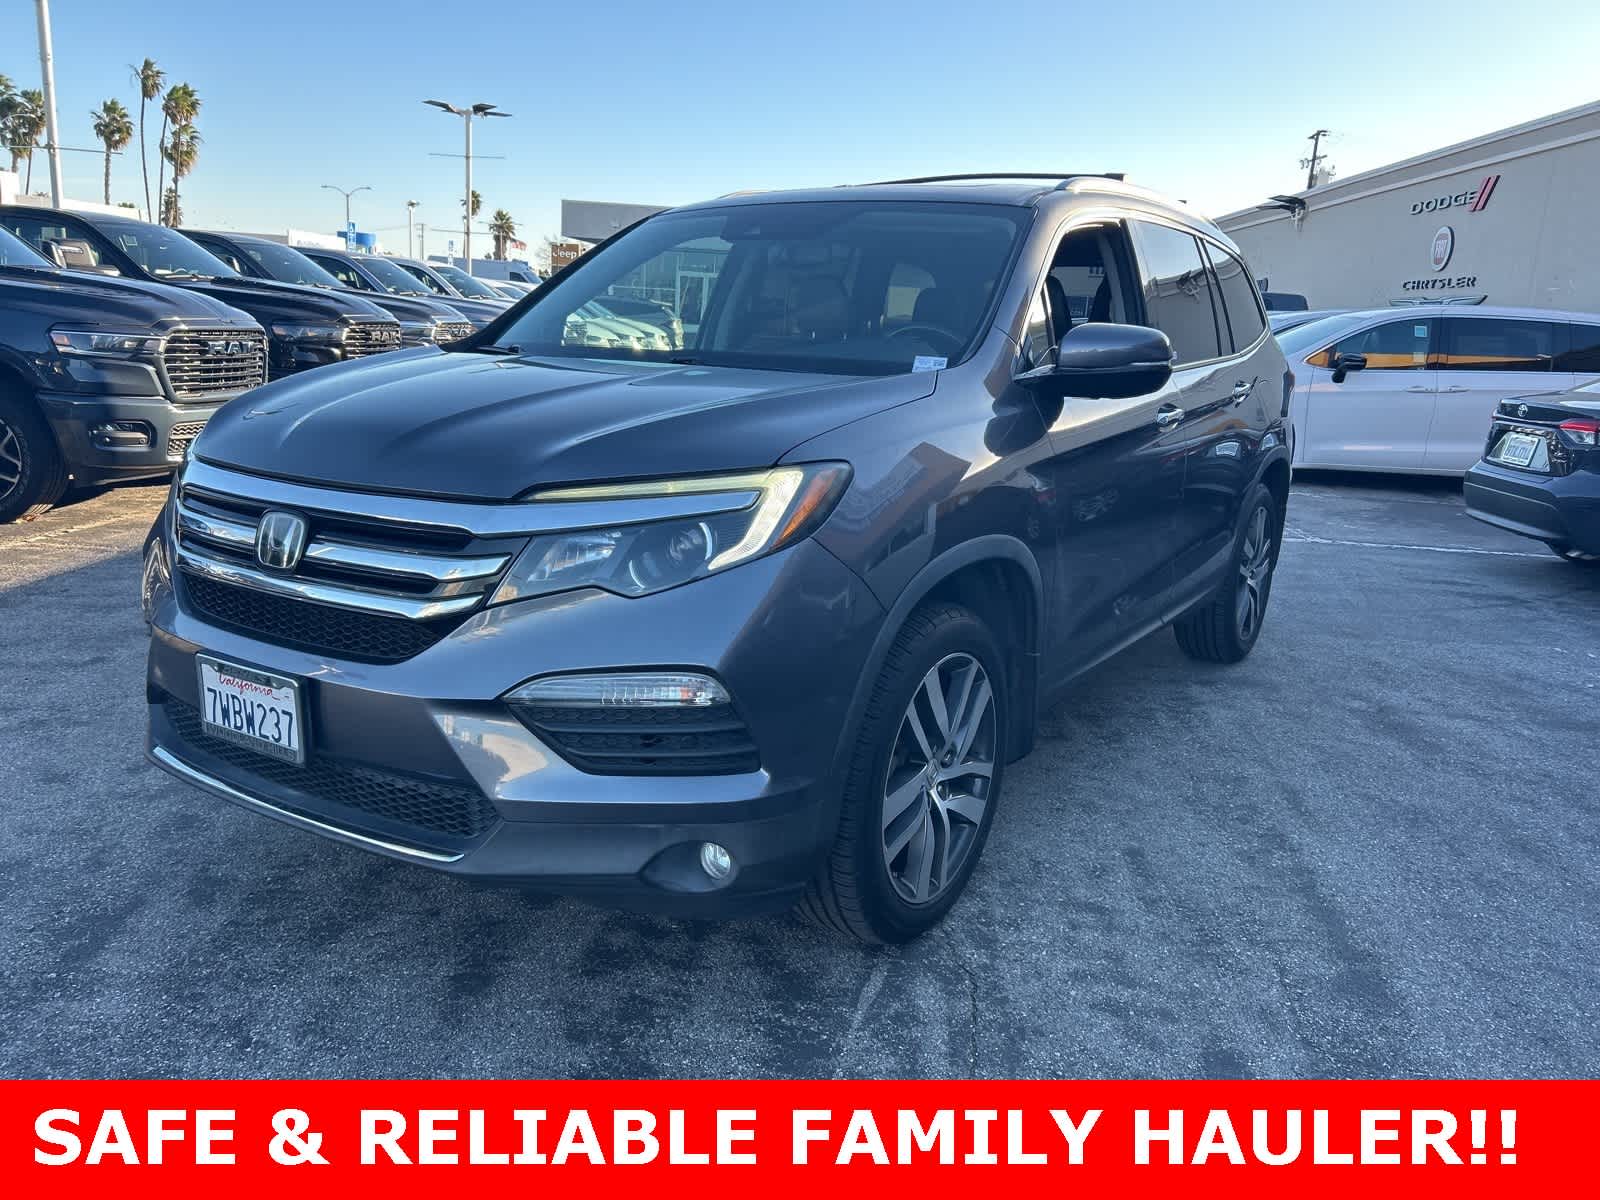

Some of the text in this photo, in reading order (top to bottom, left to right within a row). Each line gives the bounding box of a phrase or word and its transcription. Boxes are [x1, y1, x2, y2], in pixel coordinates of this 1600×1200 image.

[1410, 191, 1479, 215] DODGE
[552, 249, 578, 260] Jeep
[1402, 276, 1478, 291] CHRYSLER
[207, 687, 293, 747] 7WBW237
